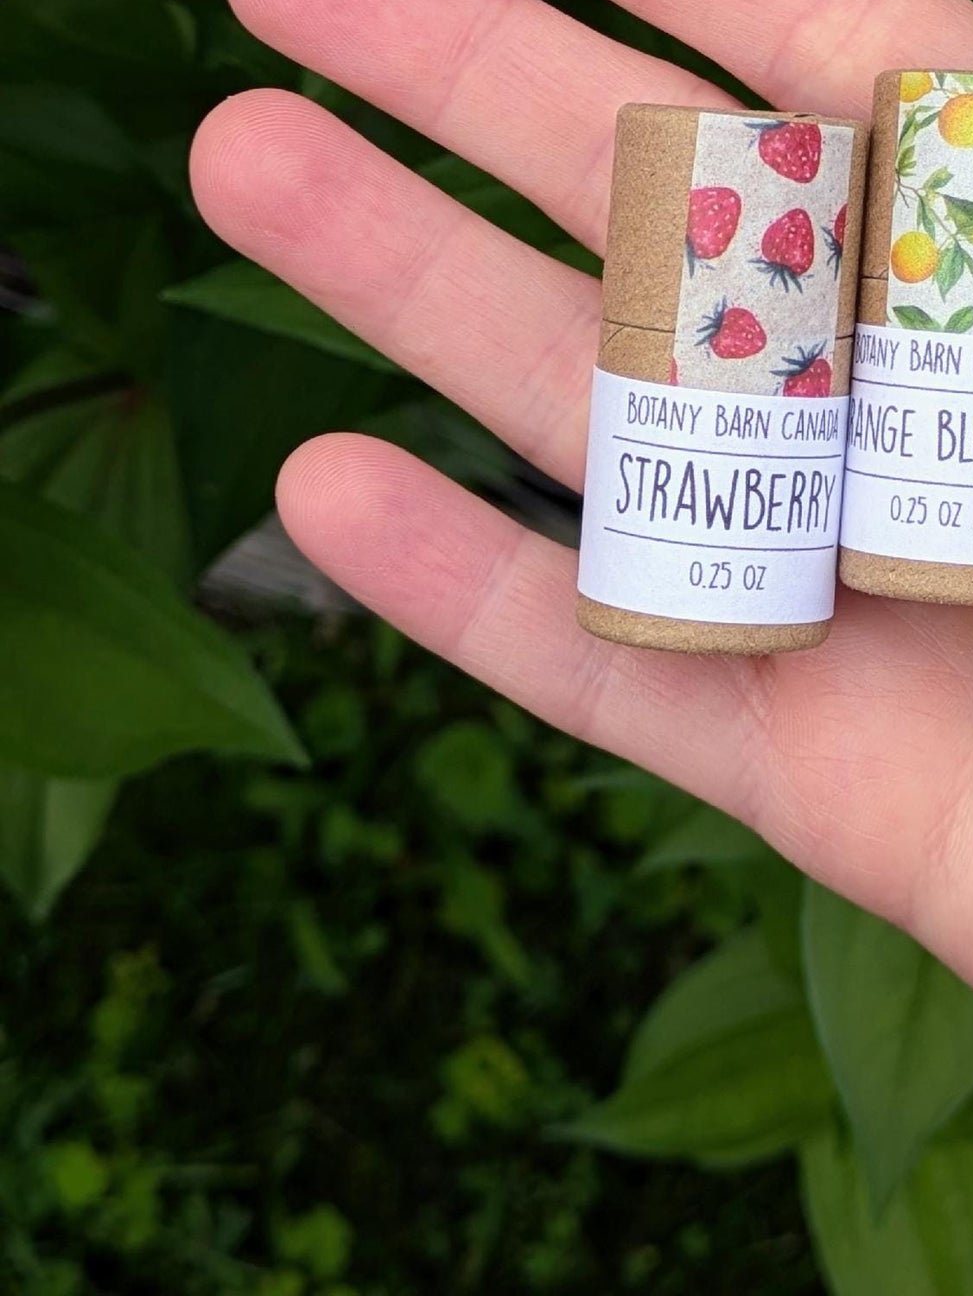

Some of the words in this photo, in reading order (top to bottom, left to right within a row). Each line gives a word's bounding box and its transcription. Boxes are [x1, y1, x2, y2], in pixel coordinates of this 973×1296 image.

[854, 333, 900, 370] BOTANY
[909, 339, 962, 375] BARN
[626, 392, 702, 435] BOTANY
[715, 405, 771, 439] BARN
[781, 407, 839, 442] CANADA
[847, 397, 915, 458] RANGE
[616, 452, 836, 533] STRAWBERRY
[890, 495, 927, 525] 0.25
[939, 501, 962, 527] OZ
[689, 561, 731, 589] 0.25
[743, 565, 766, 590] OZ
